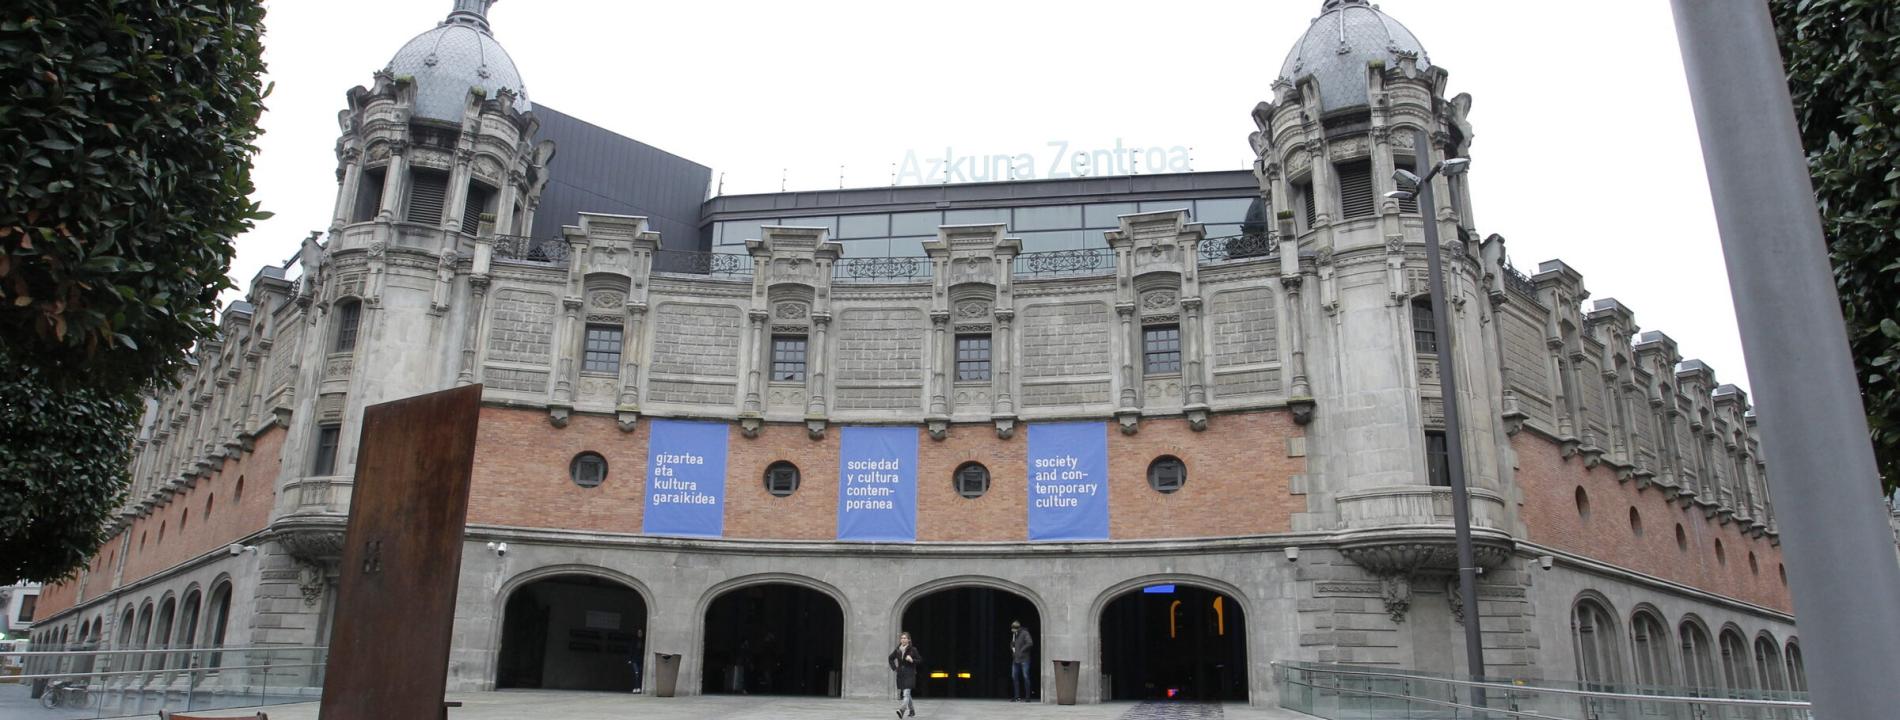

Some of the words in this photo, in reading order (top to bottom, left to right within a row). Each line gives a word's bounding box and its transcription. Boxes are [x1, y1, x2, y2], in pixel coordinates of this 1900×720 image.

[896, 147, 1036, 185] Azkuna
[1047, 137, 1190, 177] Zentroa
[656, 452, 704, 466] gizartea
[847, 458, 899, 470] sociedad
[1035, 455, 1078, 470] society
[654, 465, 673, 476] eta
[1035, 468, 1057, 481] and
[1061, 470, 1088, 480] con-
[654, 477, 697, 490] kultura
[847, 474, 854, 486] y
[857, 471, 899, 483] cultura
[847, 484, 895, 496] contem-
[1035, 482, 1098, 497] temporary
[653, 491, 716, 506] garaikidea
[846, 497, 893, 512] poránea
[1036, 495, 1078, 508] culture
